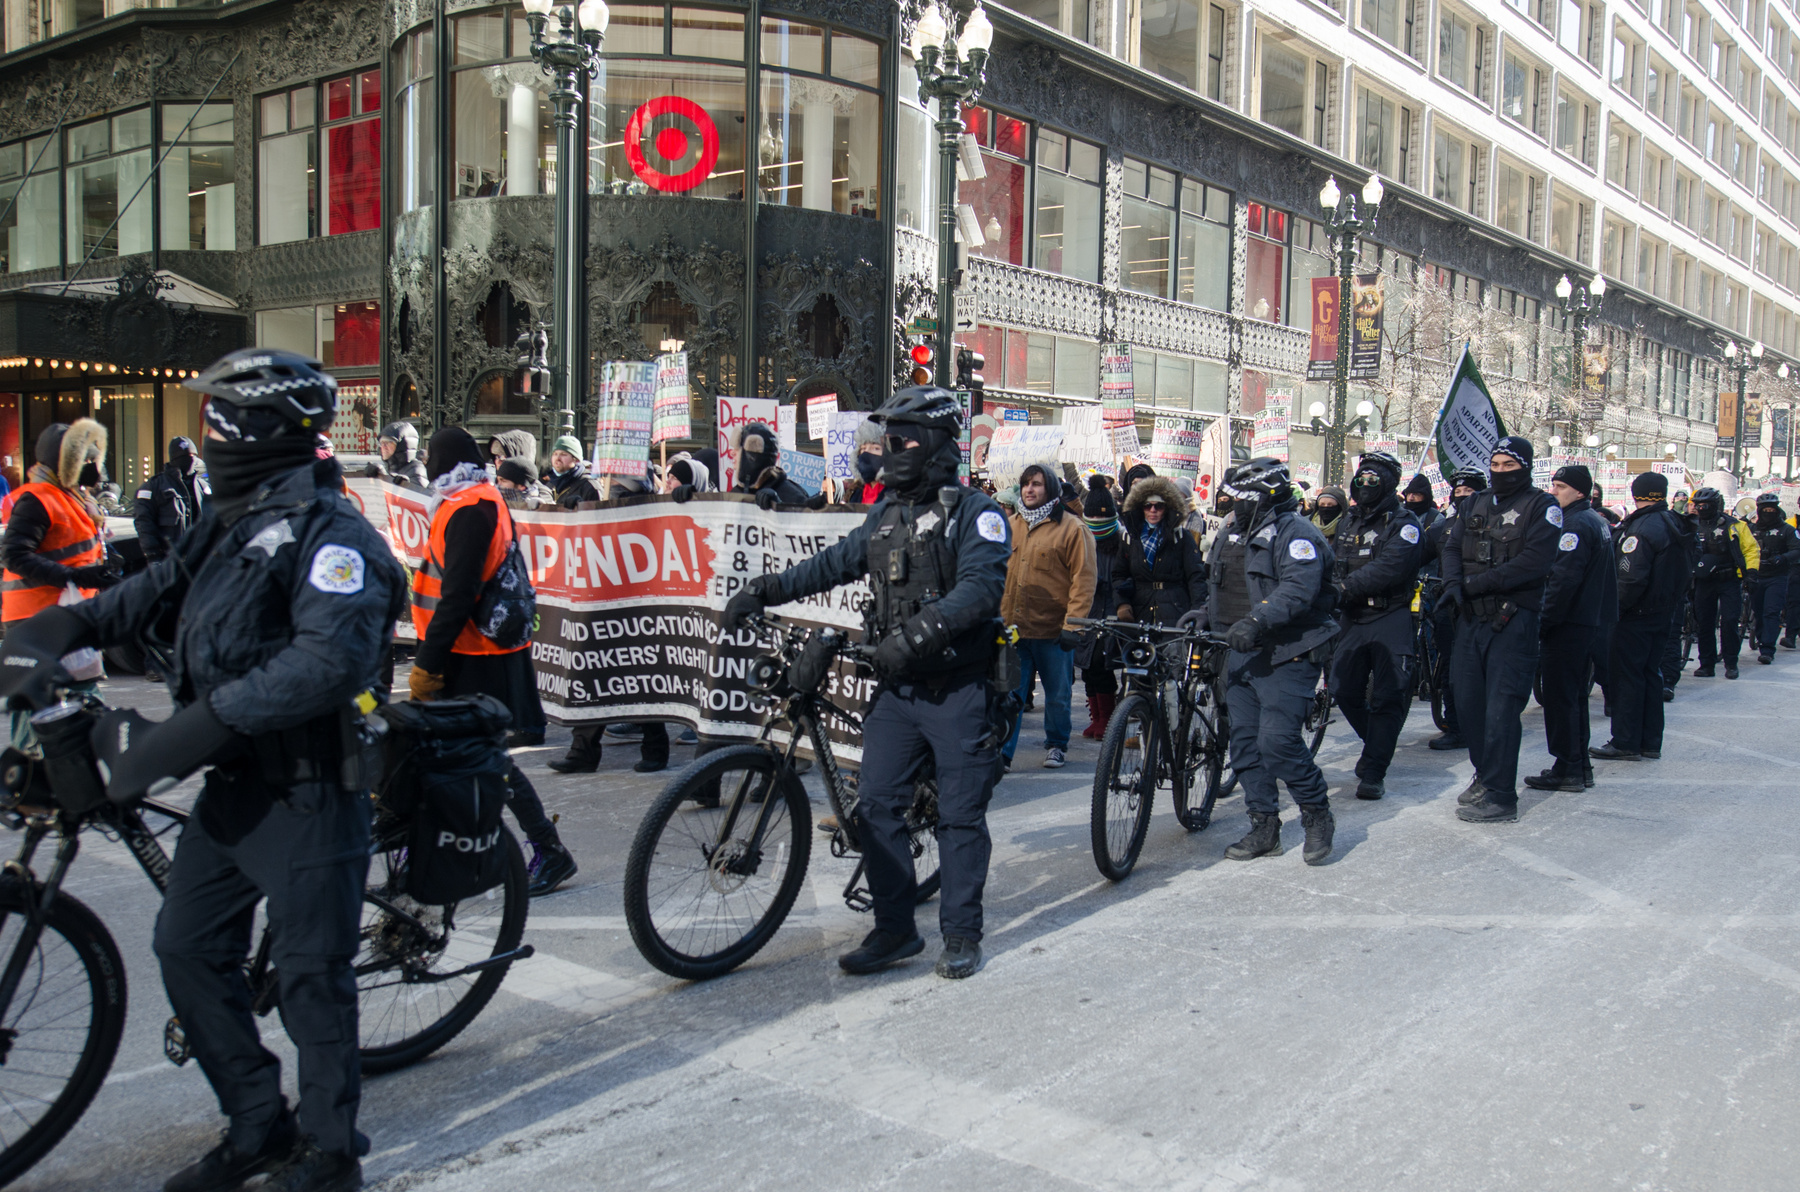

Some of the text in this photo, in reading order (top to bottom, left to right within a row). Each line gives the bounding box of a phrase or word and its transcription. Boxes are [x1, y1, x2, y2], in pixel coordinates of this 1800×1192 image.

[958, 297, 975, 307] ONE
[957, 308, 976, 317] WAY
[1314, 324, 1331, 336] Harry
[1355, 318, 1374, 330] Harry
[1320, 333, 1337, 343] Potter
[1361, 328, 1380, 339] Potter
[1109, 343, 1130, 355] THE
[233, 356, 272, 371] POLICE
[664, 354, 684, 368] THE
[625, 365, 654, 383] THE
[1266, 388, 1291, 396] STOP THE
[624, 400, 654, 408] RIGHTS
[809, 406, 837, 415] IMMIGRANT
[780, 410, 793, 424] OUR
[1255, 408, 1285, 420] STOP THE
[1482, 410, 1494, 424] NO
[623, 422, 651, 431] CRIMES
[1156, 418, 1202, 431] STOP THE
[1452, 417, 1467, 442] FUND
[1460, 405, 1497, 446] APARTHE
[634, 431, 650, 439] AND
[810, 428, 823, 437] FOR
[995, 427, 1019, 442] TRUMP
[1176, 430, 1201, 439] AGENDA!
[1365, 433, 1396, 442] STOP THE
[623, 439, 649, 447] RIGHTS
[1443, 420, 1453, 443] HELP
[1451, 442, 1468, 462] THE
[792, 454, 825, 468] TRUMP
[610, 466, 646, 476] FREEDOM
[793, 466, 823, 482] KKK
[807, 480, 821, 488] USA
[724, 523, 826, 555] FIGHT THE
[319, 549, 361, 571] CHICAGO
[733, 550, 749, 572] &
[320, 572, 359, 589] POLICE
[592, 615, 703, 640] EDUCATION
[594, 674, 690, 698] LGBTQIA+
[816, 720, 836, 772] CHICAGO
[438, 826, 500, 852] POLI
